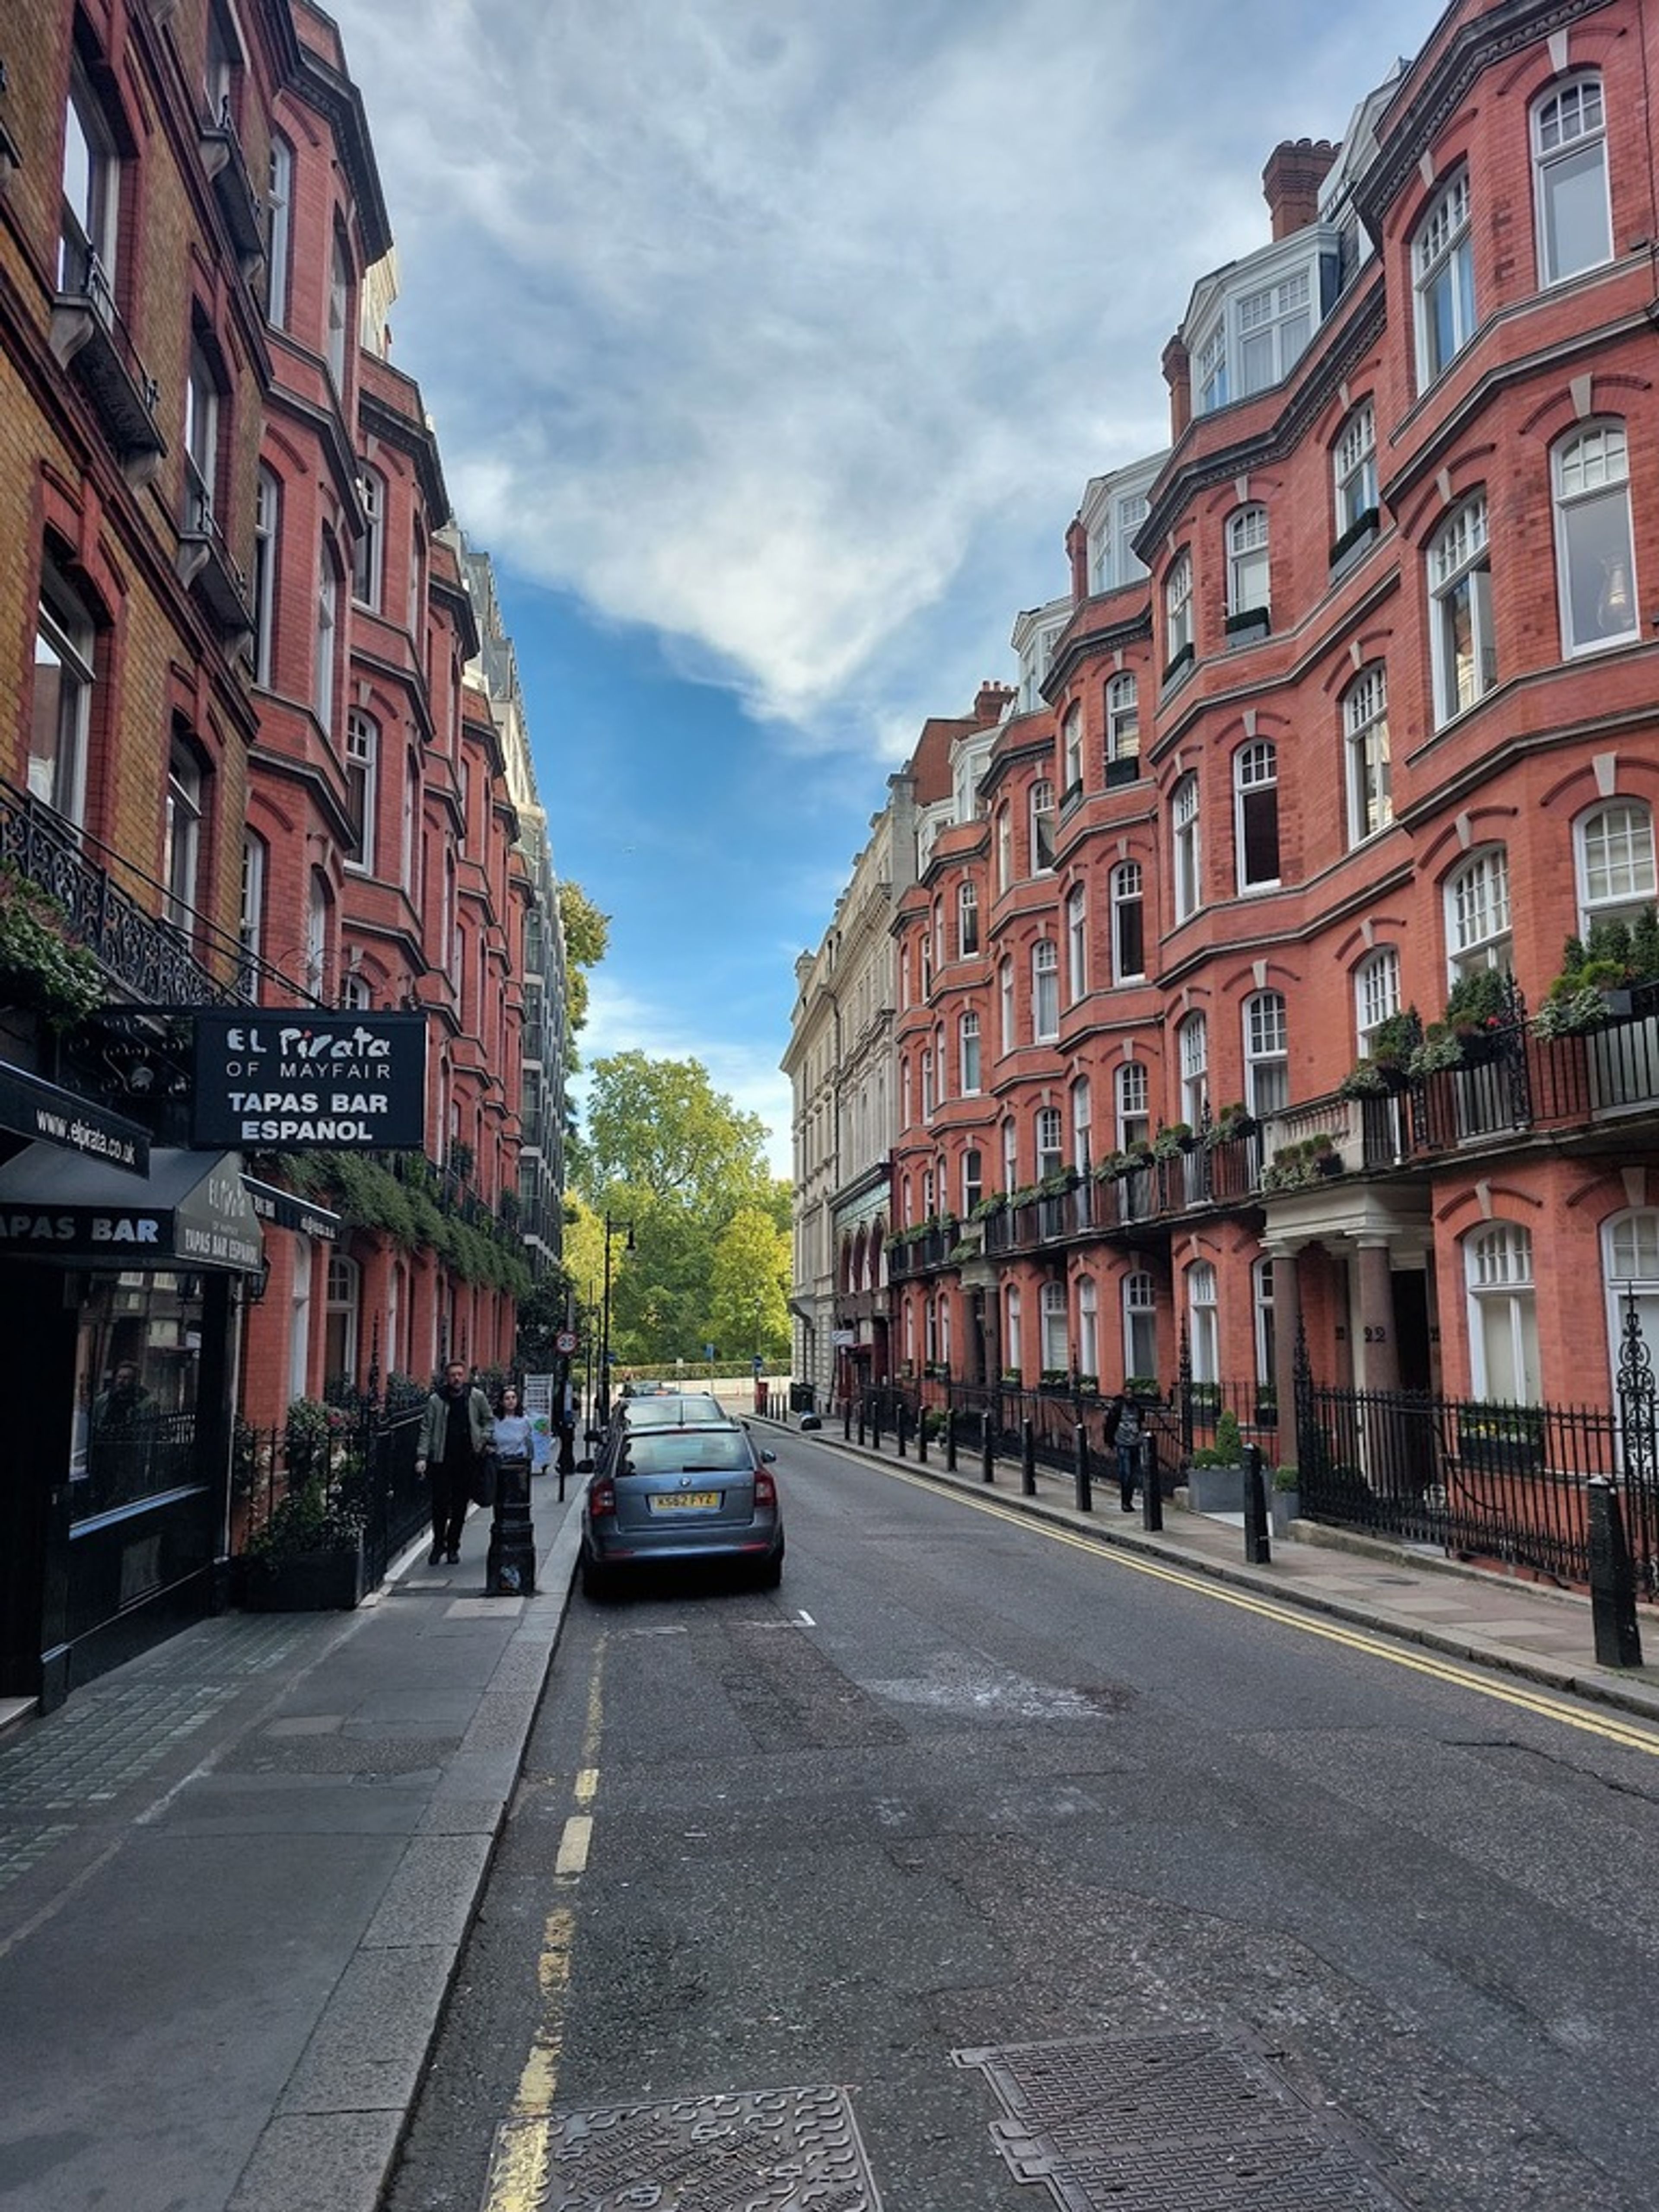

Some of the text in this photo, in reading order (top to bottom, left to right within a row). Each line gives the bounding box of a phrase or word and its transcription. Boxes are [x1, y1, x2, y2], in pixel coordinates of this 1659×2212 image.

[226, 1025, 390, 1058] EL Pirata
[226, 1062, 390, 1079] OF MAYFAIR
[228, 1092, 388, 1113] TAPAS BAR
[91, 1218, 159, 1243] BAR
